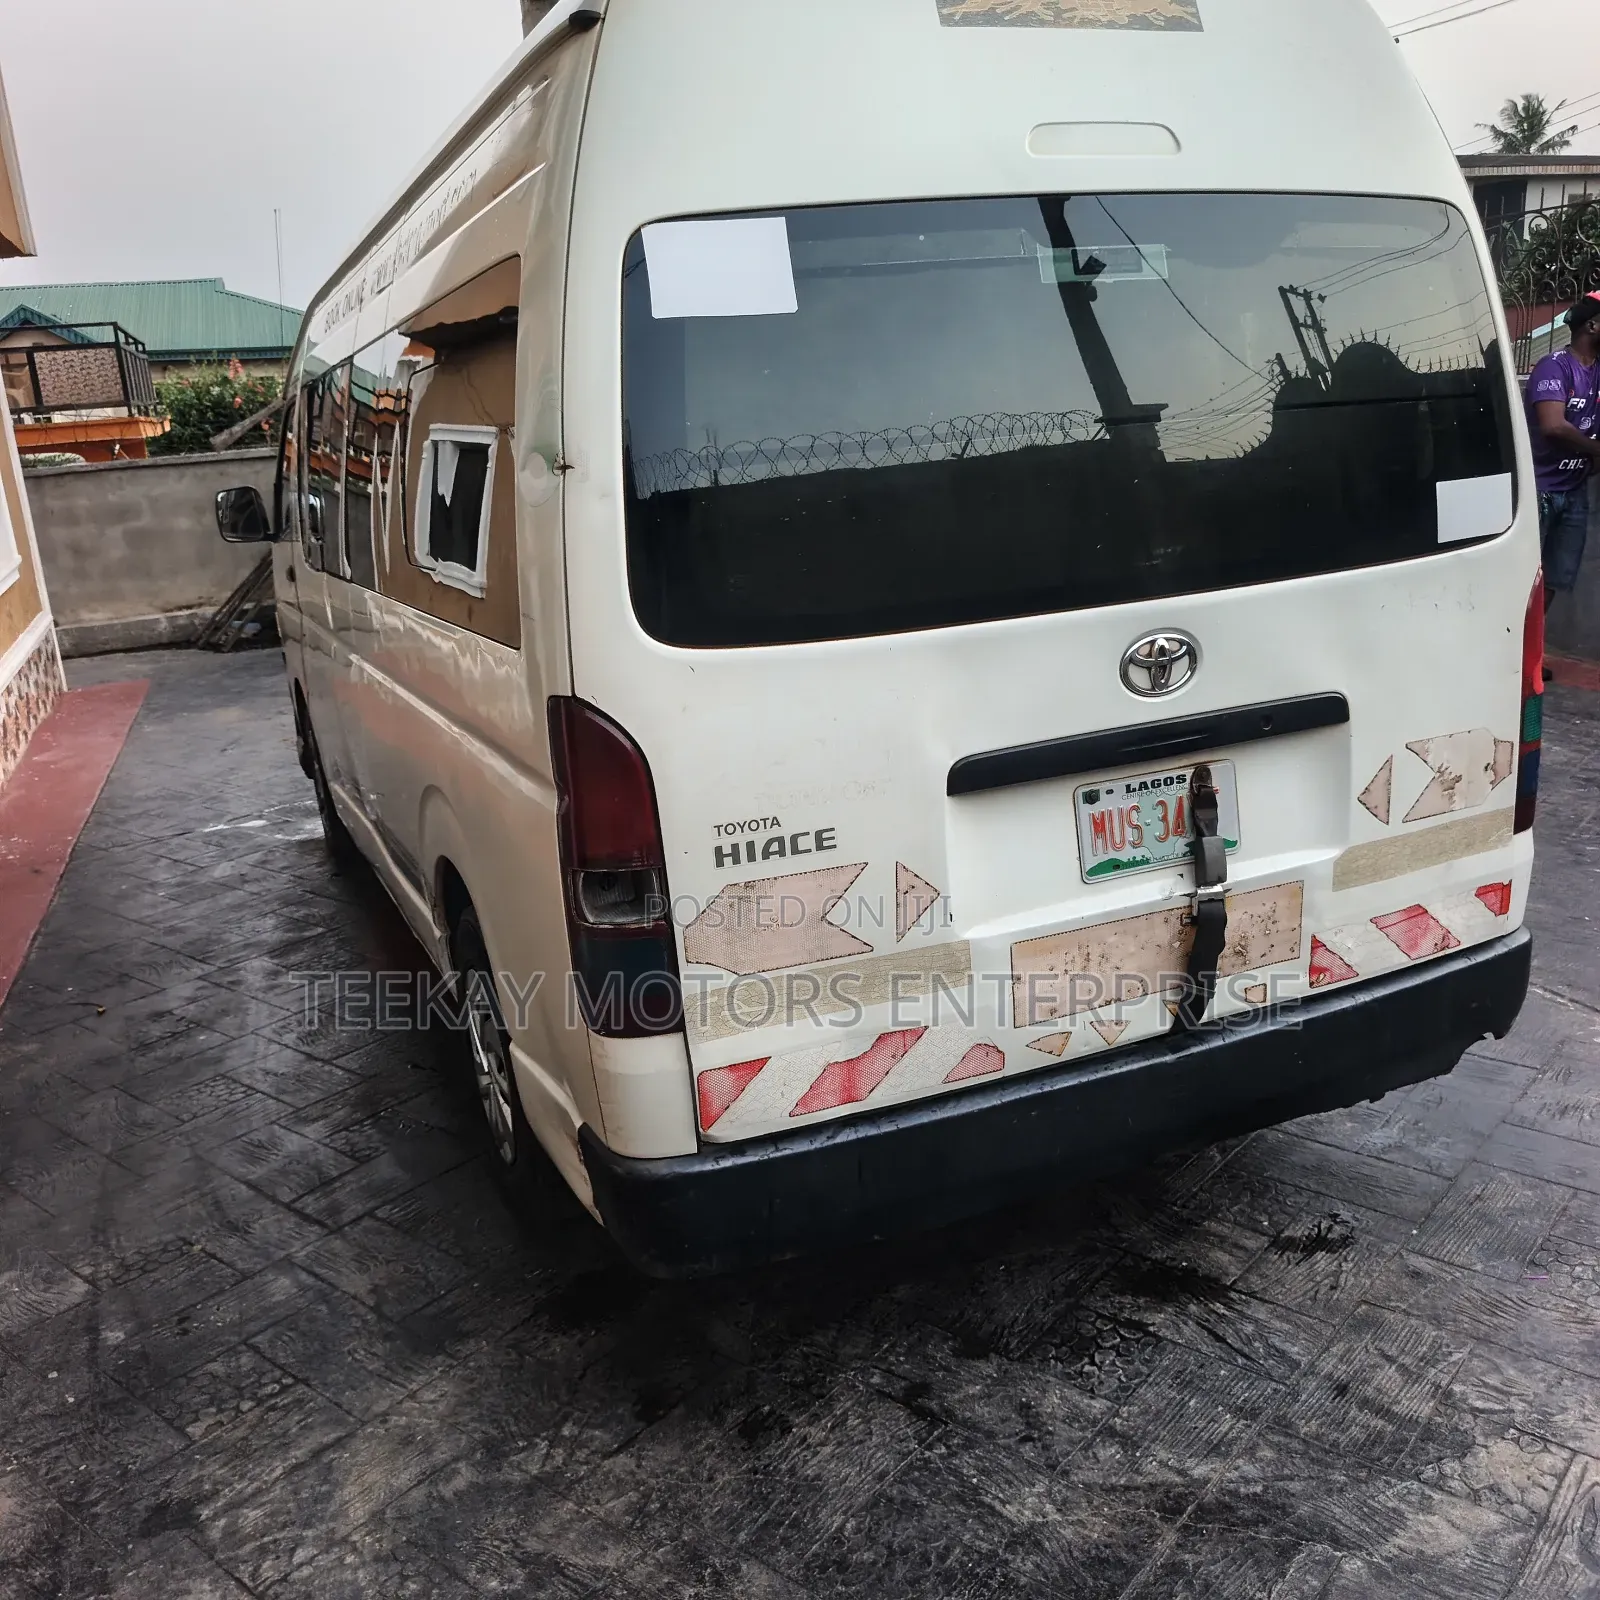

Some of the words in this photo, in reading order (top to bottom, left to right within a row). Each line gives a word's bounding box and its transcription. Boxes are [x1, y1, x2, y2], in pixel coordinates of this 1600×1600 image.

[1124, 774, 1187, 794] LAGOS
[713, 816, 782, 838] TOYOTA
[714, 827, 838, 868] HIACE
